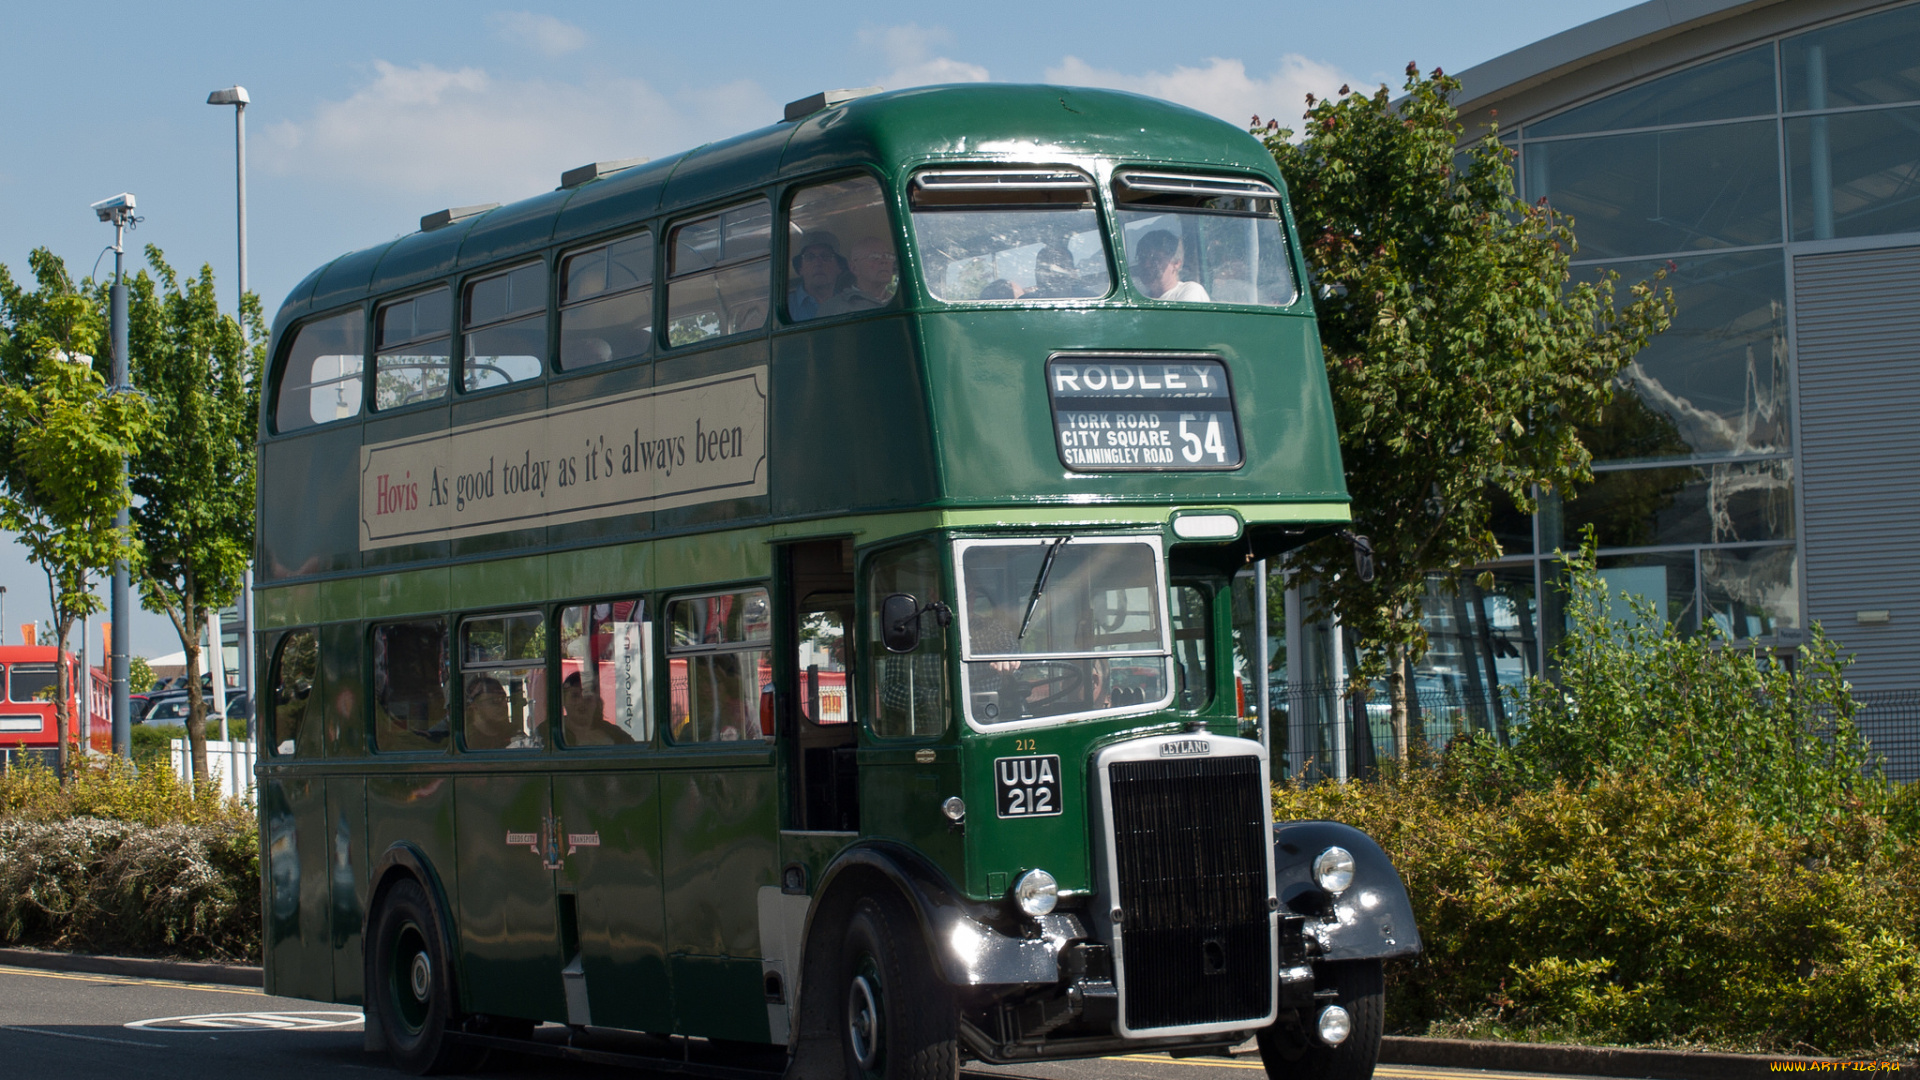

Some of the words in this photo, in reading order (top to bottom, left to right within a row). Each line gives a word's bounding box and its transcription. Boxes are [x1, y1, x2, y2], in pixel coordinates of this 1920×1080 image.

[1055, 365, 1212, 391] RODLEY
[1067, 414, 1110, 429] YORK
[1117, 414, 1160, 429] ROAD
[1062, 431, 1100, 446] CITY
[1107, 431, 1171, 447] SQUARE
[1179, 414, 1226, 463] 54
[376, 471, 418, 516] Hovis
[428, 466, 449, 508] As
[456, 456, 494, 511] good
[503, 450, 551, 498] today
[558, 453, 577, 488] as
[585, 435, 614, 482] it's
[622, 428, 686, 477] always
[696, 418, 743, 464] been
[1064, 448, 1140, 464] STANNINGLEY
[1144, 448, 1174, 463] ROAD
[624, 655, 633, 728] Approved
[1016, 739, 1036, 751] 212
[1162, 741, 1209, 754] LEYLAND
[1002, 759, 1054, 786] UUA
[1008, 787, 1052, 814] 212
